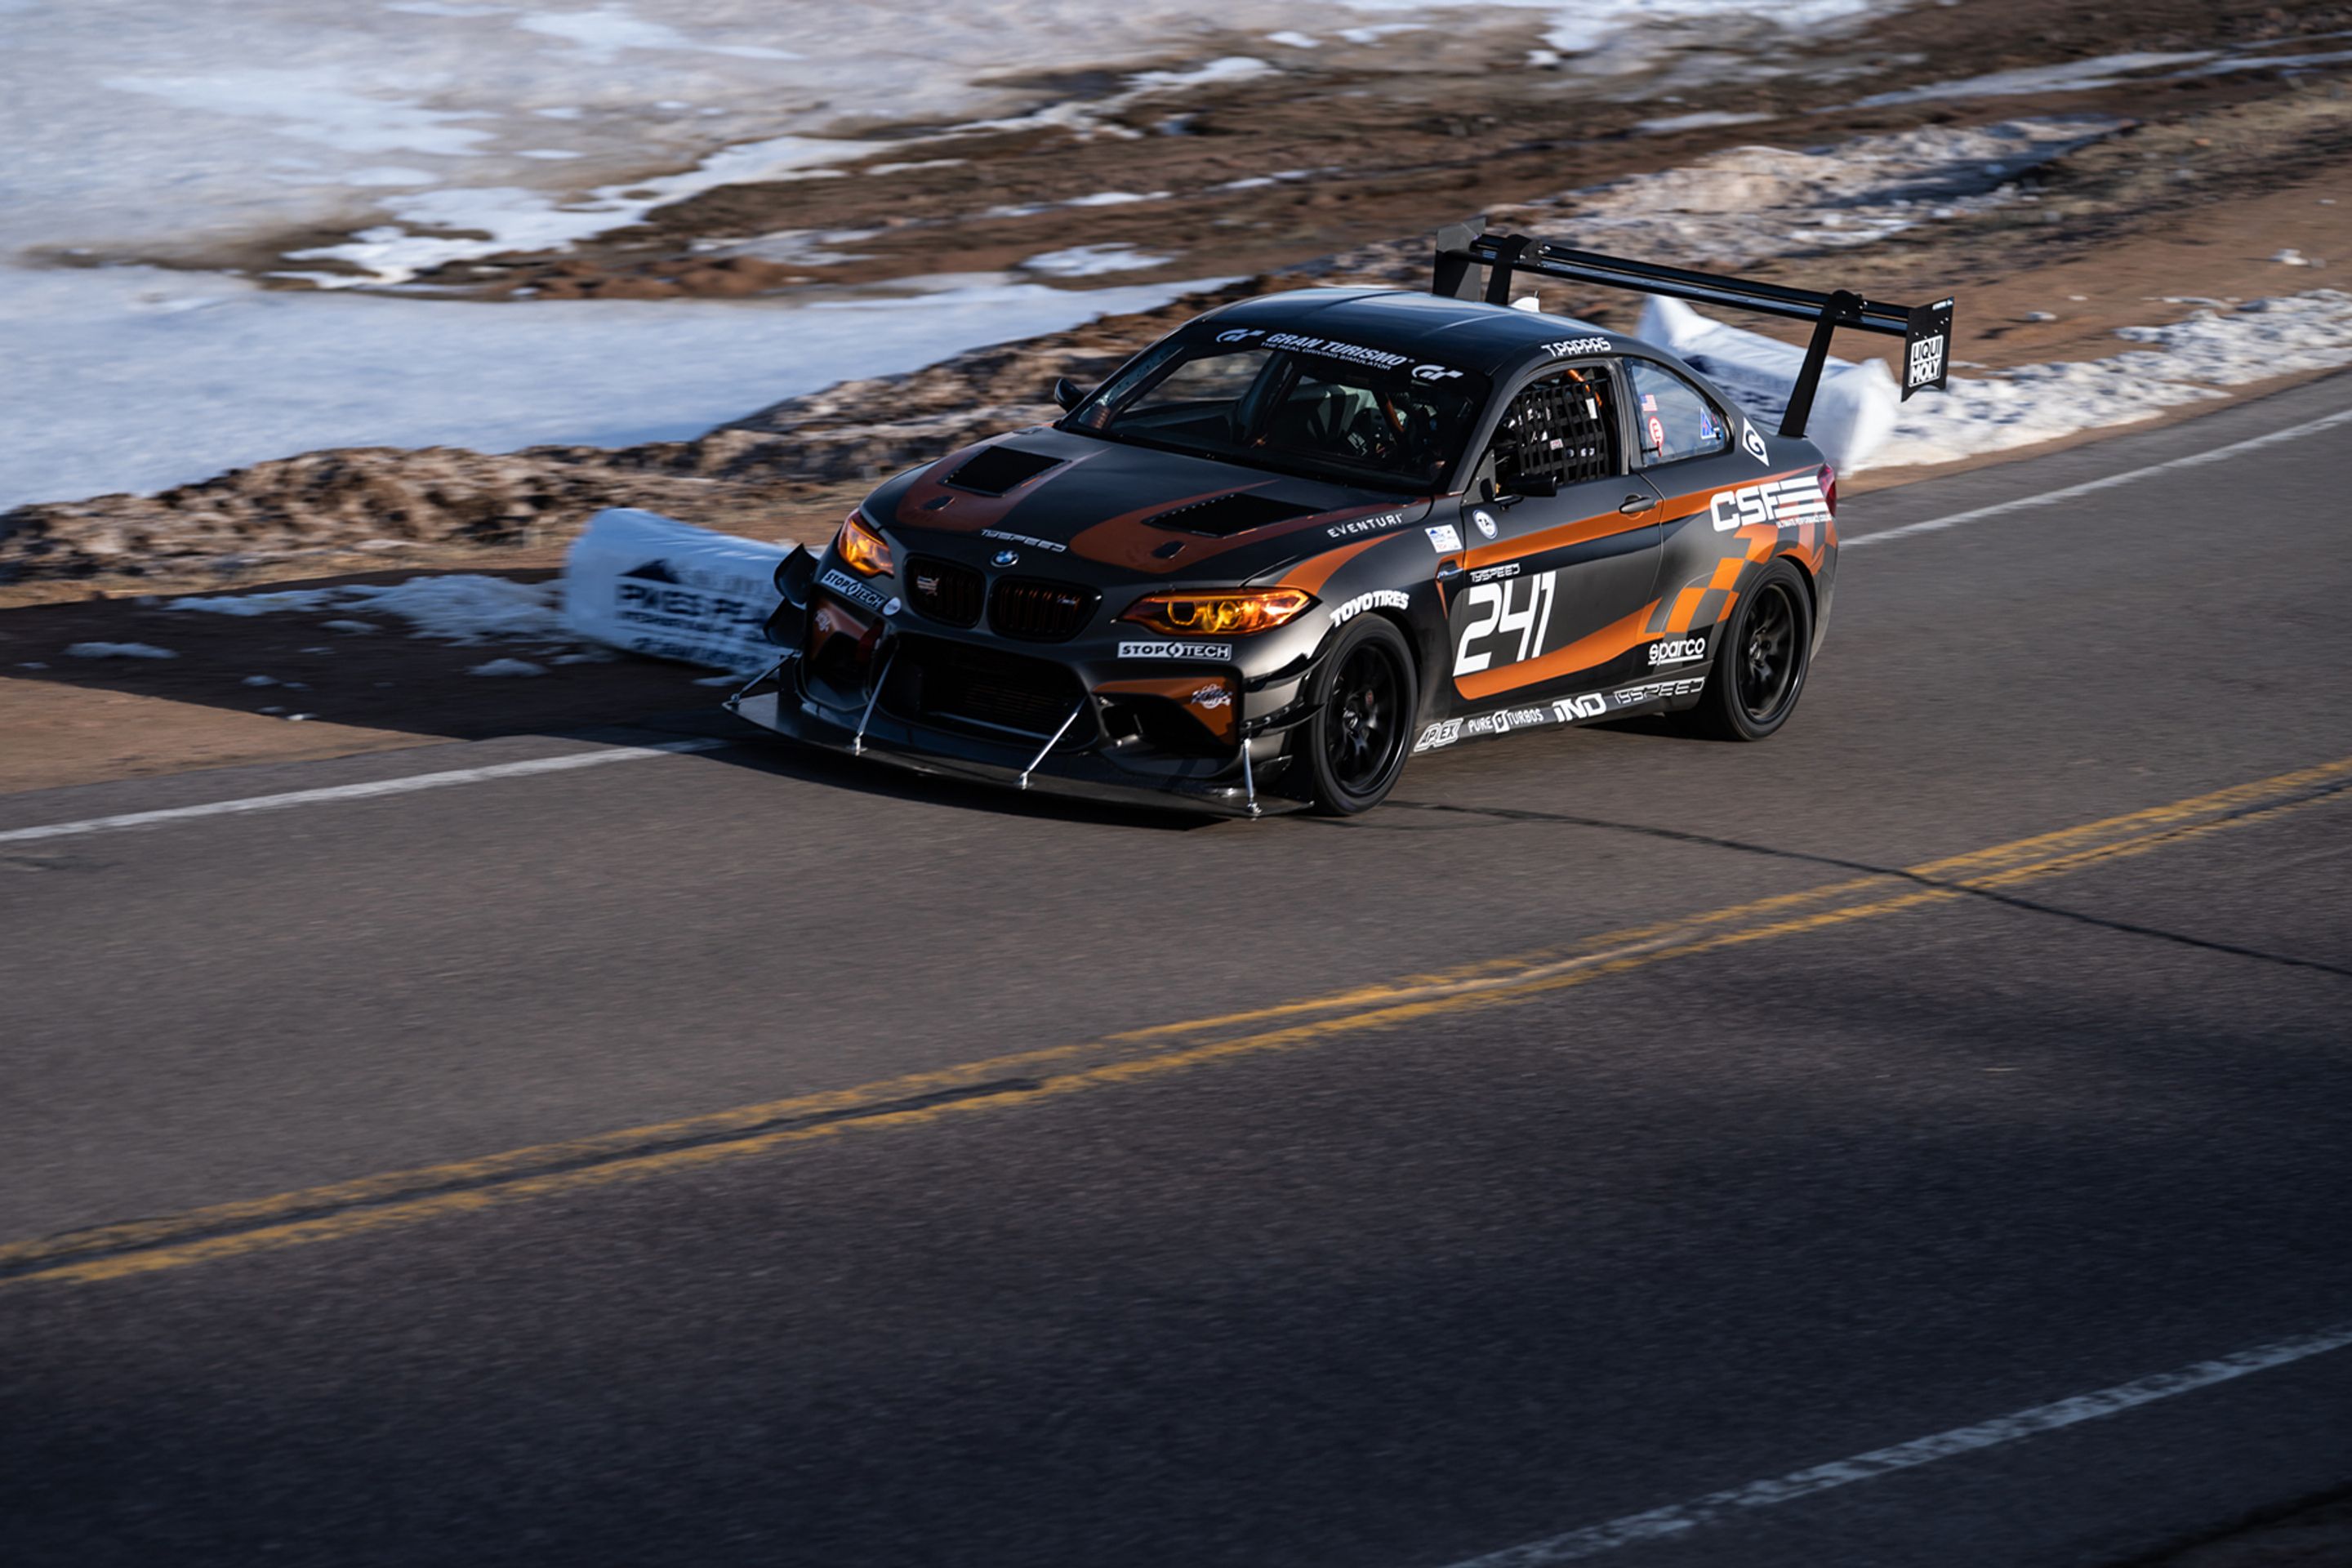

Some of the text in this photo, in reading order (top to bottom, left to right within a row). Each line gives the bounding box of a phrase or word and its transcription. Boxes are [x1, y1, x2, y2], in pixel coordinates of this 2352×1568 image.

[1267, 332, 1409, 366] GRAN TURISMO
[1278, 343, 1299, 352] REAL
[1302, 347, 1339, 359] DRIVING
[1339, 354, 1392, 371] SIMULATOR
[1913, 337, 1941, 362] LIQUI
[1911, 359, 1941, 384] MOLY
[1710, 482, 1781, 532] CSF
[1327, 514, 1401, 538] EVENTURI
[1330, 590, 1410, 627] TOYO TIRES
[1452, 570, 1557, 676] 241
[1649, 637, 1706, 666] sparco
[1418, 721, 1461, 747] APEX
[1468, 708, 1544, 733] PURE TURBOS
